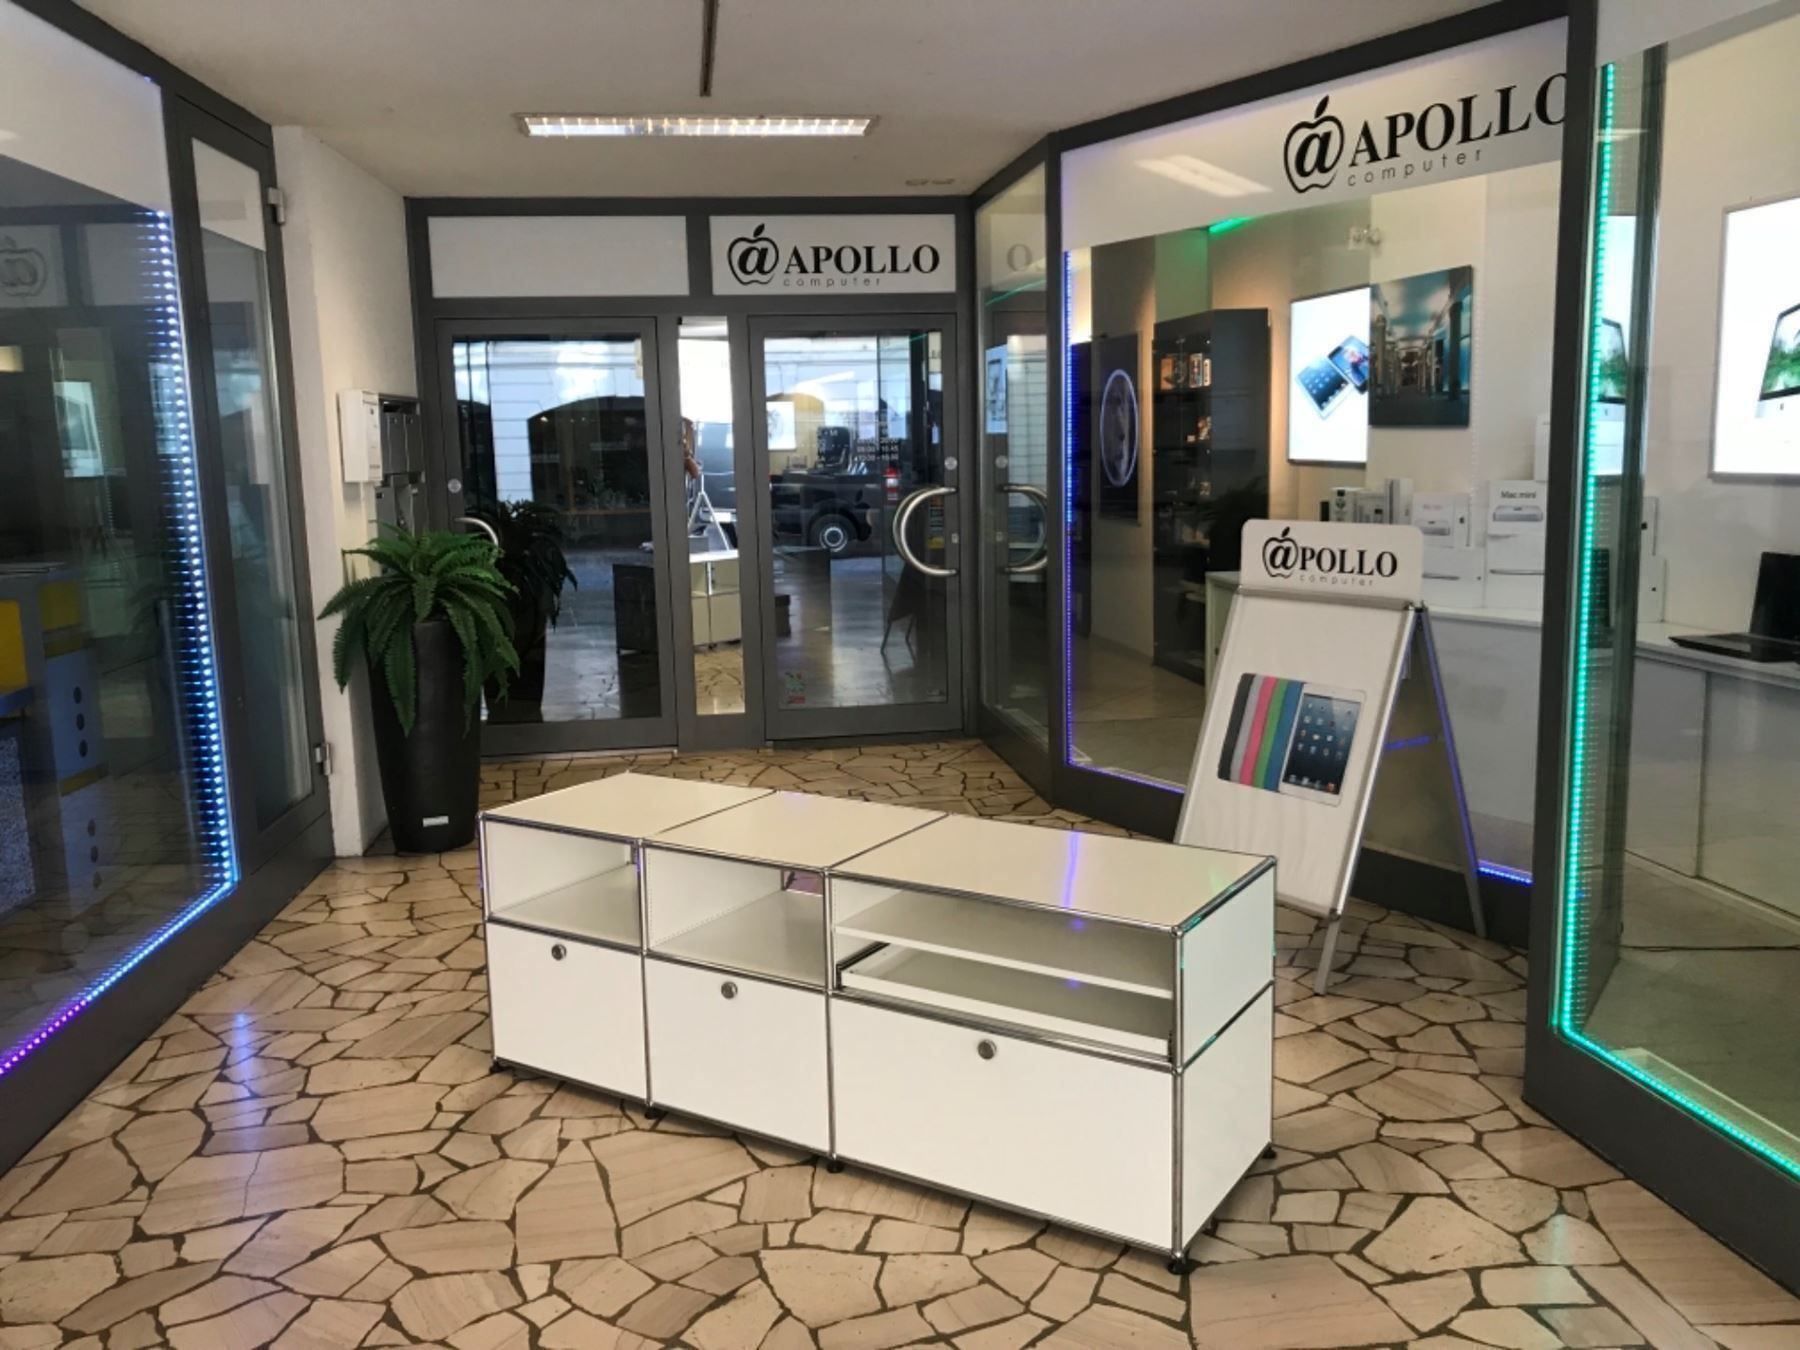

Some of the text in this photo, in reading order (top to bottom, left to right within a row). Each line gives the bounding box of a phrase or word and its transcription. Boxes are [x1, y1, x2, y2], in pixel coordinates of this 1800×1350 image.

[1347, 148, 1483, 188] computer
[783, 244, 941, 275] APOLLO
[783, 275, 882, 288] computer
[1299, 573, 1375, 588] computer
